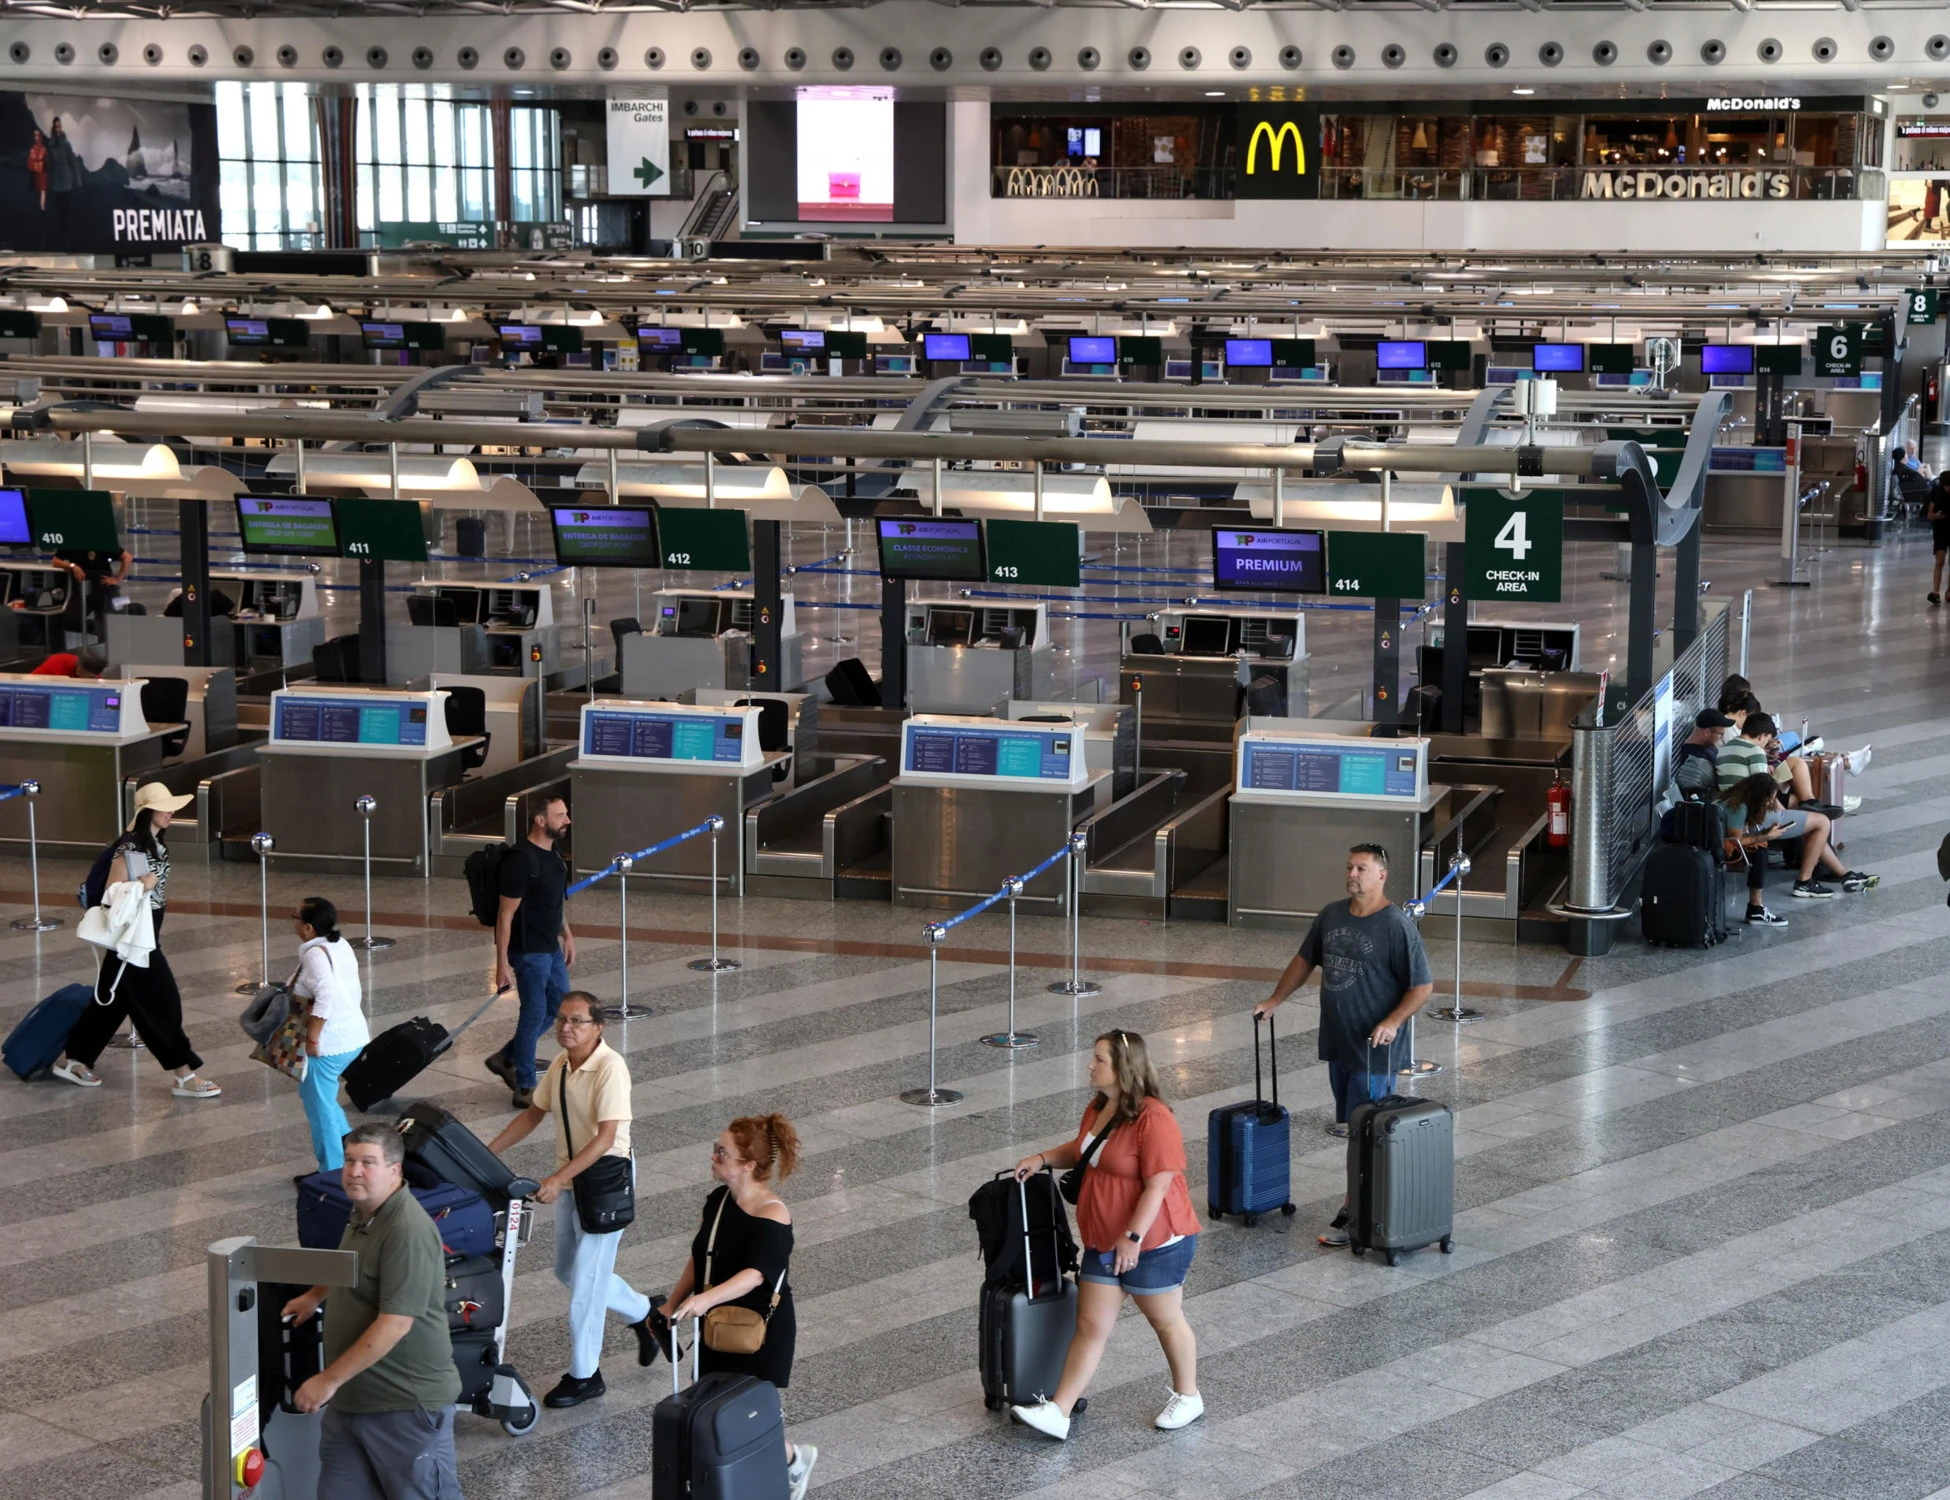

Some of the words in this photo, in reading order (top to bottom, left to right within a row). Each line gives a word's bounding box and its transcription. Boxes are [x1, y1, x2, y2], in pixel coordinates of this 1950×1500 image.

[611, 102, 663, 112] IMBARCHI
[1707, 97, 1801, 111] McDonald's
[634, 113, 663, 123] Gates
[1581, 172, 1790, 199] McDonald's
[113, 209, 207, 241] PREMIATA
[688, 243, 703, 256] 10
[200, 252, 212, 270] 8
[1914, 295, 1926, 312] 8
[1830, 335, 1848, 359] 6
[42, 533, 64, 544] 410
[598, 532, 608, 540] DE
[1235, 534, 1254, 546] TAP
[1494, 511, 1532, 560] 4
[349, 542, 370, 554] 411
[893, 544, 921, 552] CLASSE
[668, 553, 691, 564] 412
[1236, 558, 1303, 572] PREMIUM
[995, 566, 1018, 578] 413
[1485, 570, 1540, 581] CHECK-IN
[1335, 579, 1360, 591] 414
[1496, 582, 1527, 592] AREA
[509, 1202, 520, 1231] 0124
